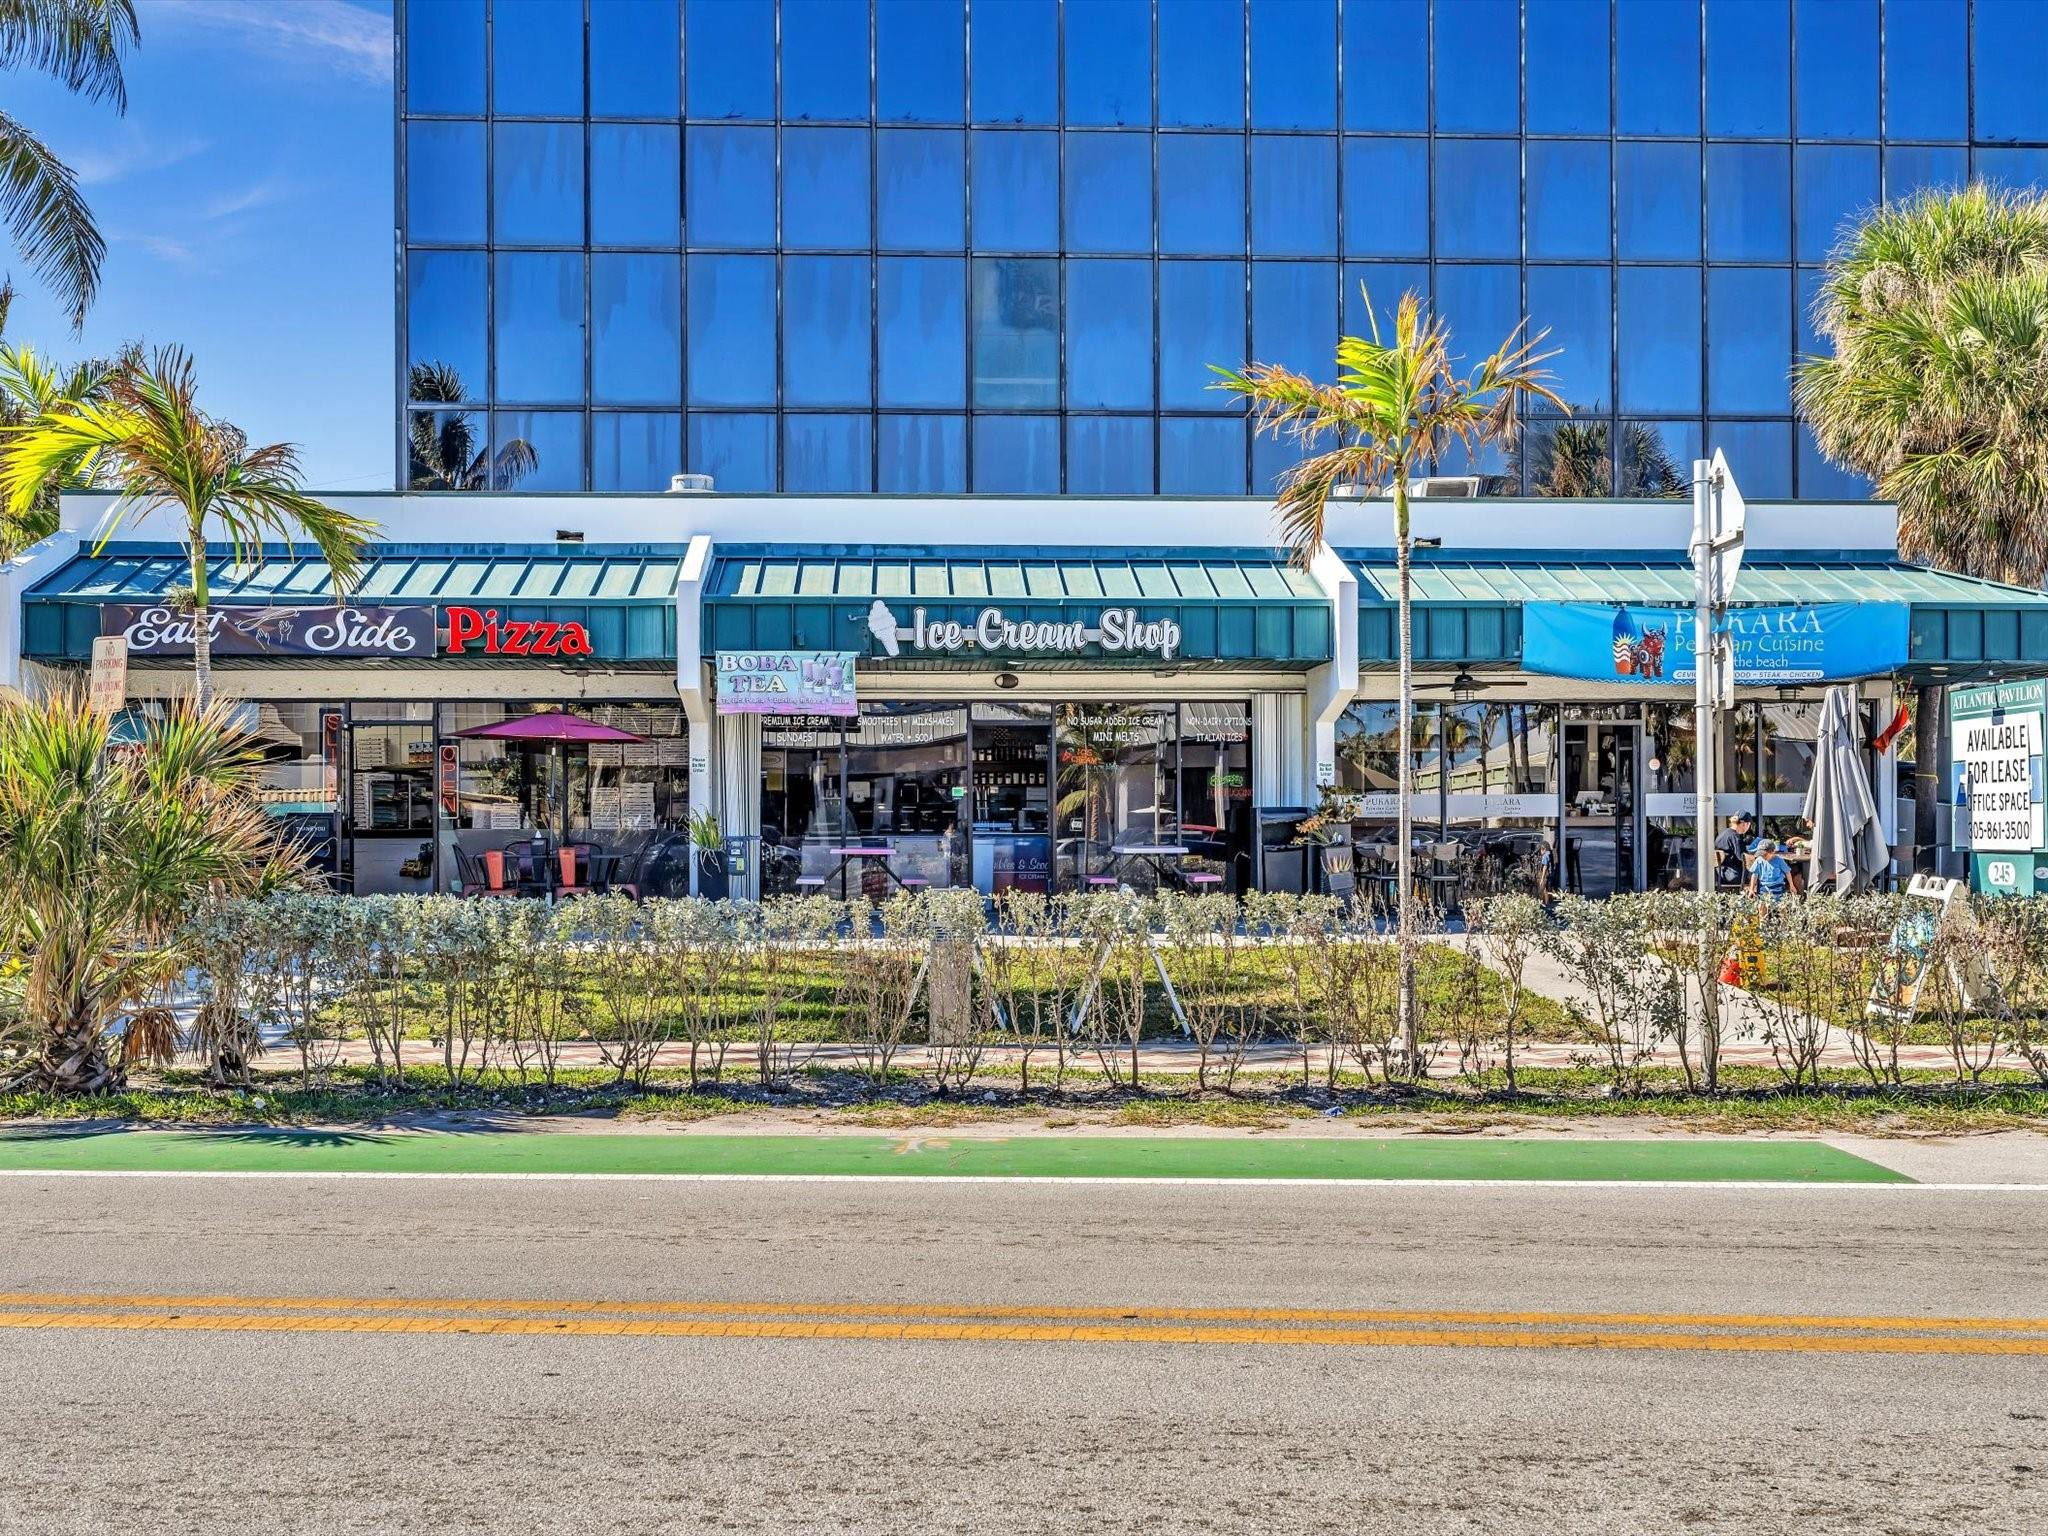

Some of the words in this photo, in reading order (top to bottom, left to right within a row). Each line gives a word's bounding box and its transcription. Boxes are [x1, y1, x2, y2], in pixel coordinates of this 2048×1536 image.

[305, 608, 416, 652] Side
[1674, 609, 1825, 634] PKARA
[445, 606, 593, 656] Pizza
[913, 607, 964, 650] Ice
[976, 606, 1088, 651] Cream
[1099, 607, 1181, 661] Shop
[1675, 635, 1752, 652] Pean
[1758, 635, 1825, 652] Cuisine
[96, 658, 124, 669] PARKING
[719, 654, 798, 672] BOBA
[1734, 655, 1752, 667] the
[1756, 654, 1789, 668] beach
[730, 675, 788, 692] TEA
[1758, 671, 1781, 679] STEAK
[1788, 671, 1822, 679] CHICKEN
[1953, 690, 1997, 710] ATLANTIC
[1999, 684, 2044, 704] PAVILION
[760, 716, 791, 726] PREMIUM
[792, 716, 805, 726] ICE
[806, 716, 830, 726] CREAM
[857, 716, 899, 727] SMOOTHIES
[911, 716, 955, 727] MILKSHAKES
[1067, 716, 1079, 726] NO
[1080, 716, 1103, 726] SUGAR
[1104, 716, 1127, 726] ADDED
[1128, 716, 1141, 726] ICE
[1142, 716, 1165, 726] CREAM
[1186, 716, 1222, 726] NON-DAIRY
[1223, 716, 1252, 726] OPTIONS
[776, 732, 813, 743] SUNDAES
[880, 733, 905, 743] WATER
[915, 733, 934, 743] SODA
[1093, 732, 1113, 742] MINI
[1115, 732, 1140, 742] MELTS
[1196, 732, 1226, 742] ITALIAN
[1227, 732, 1243, 742] ICES
[1967, 725, 2027, 753] AVAILABLE
[442, 747, 456, 813] OPEN
[1967, 760, 1988, 784] FOR
[1991, 759, 2027, 783] LEASE
[1967, 793, 1997, 811] OFFICE
[1998, 792, 2029, 811] SPACE
[1968, 821, 2030, 840] 305-861-3500
[1993, 865, 2011, 882] 245
